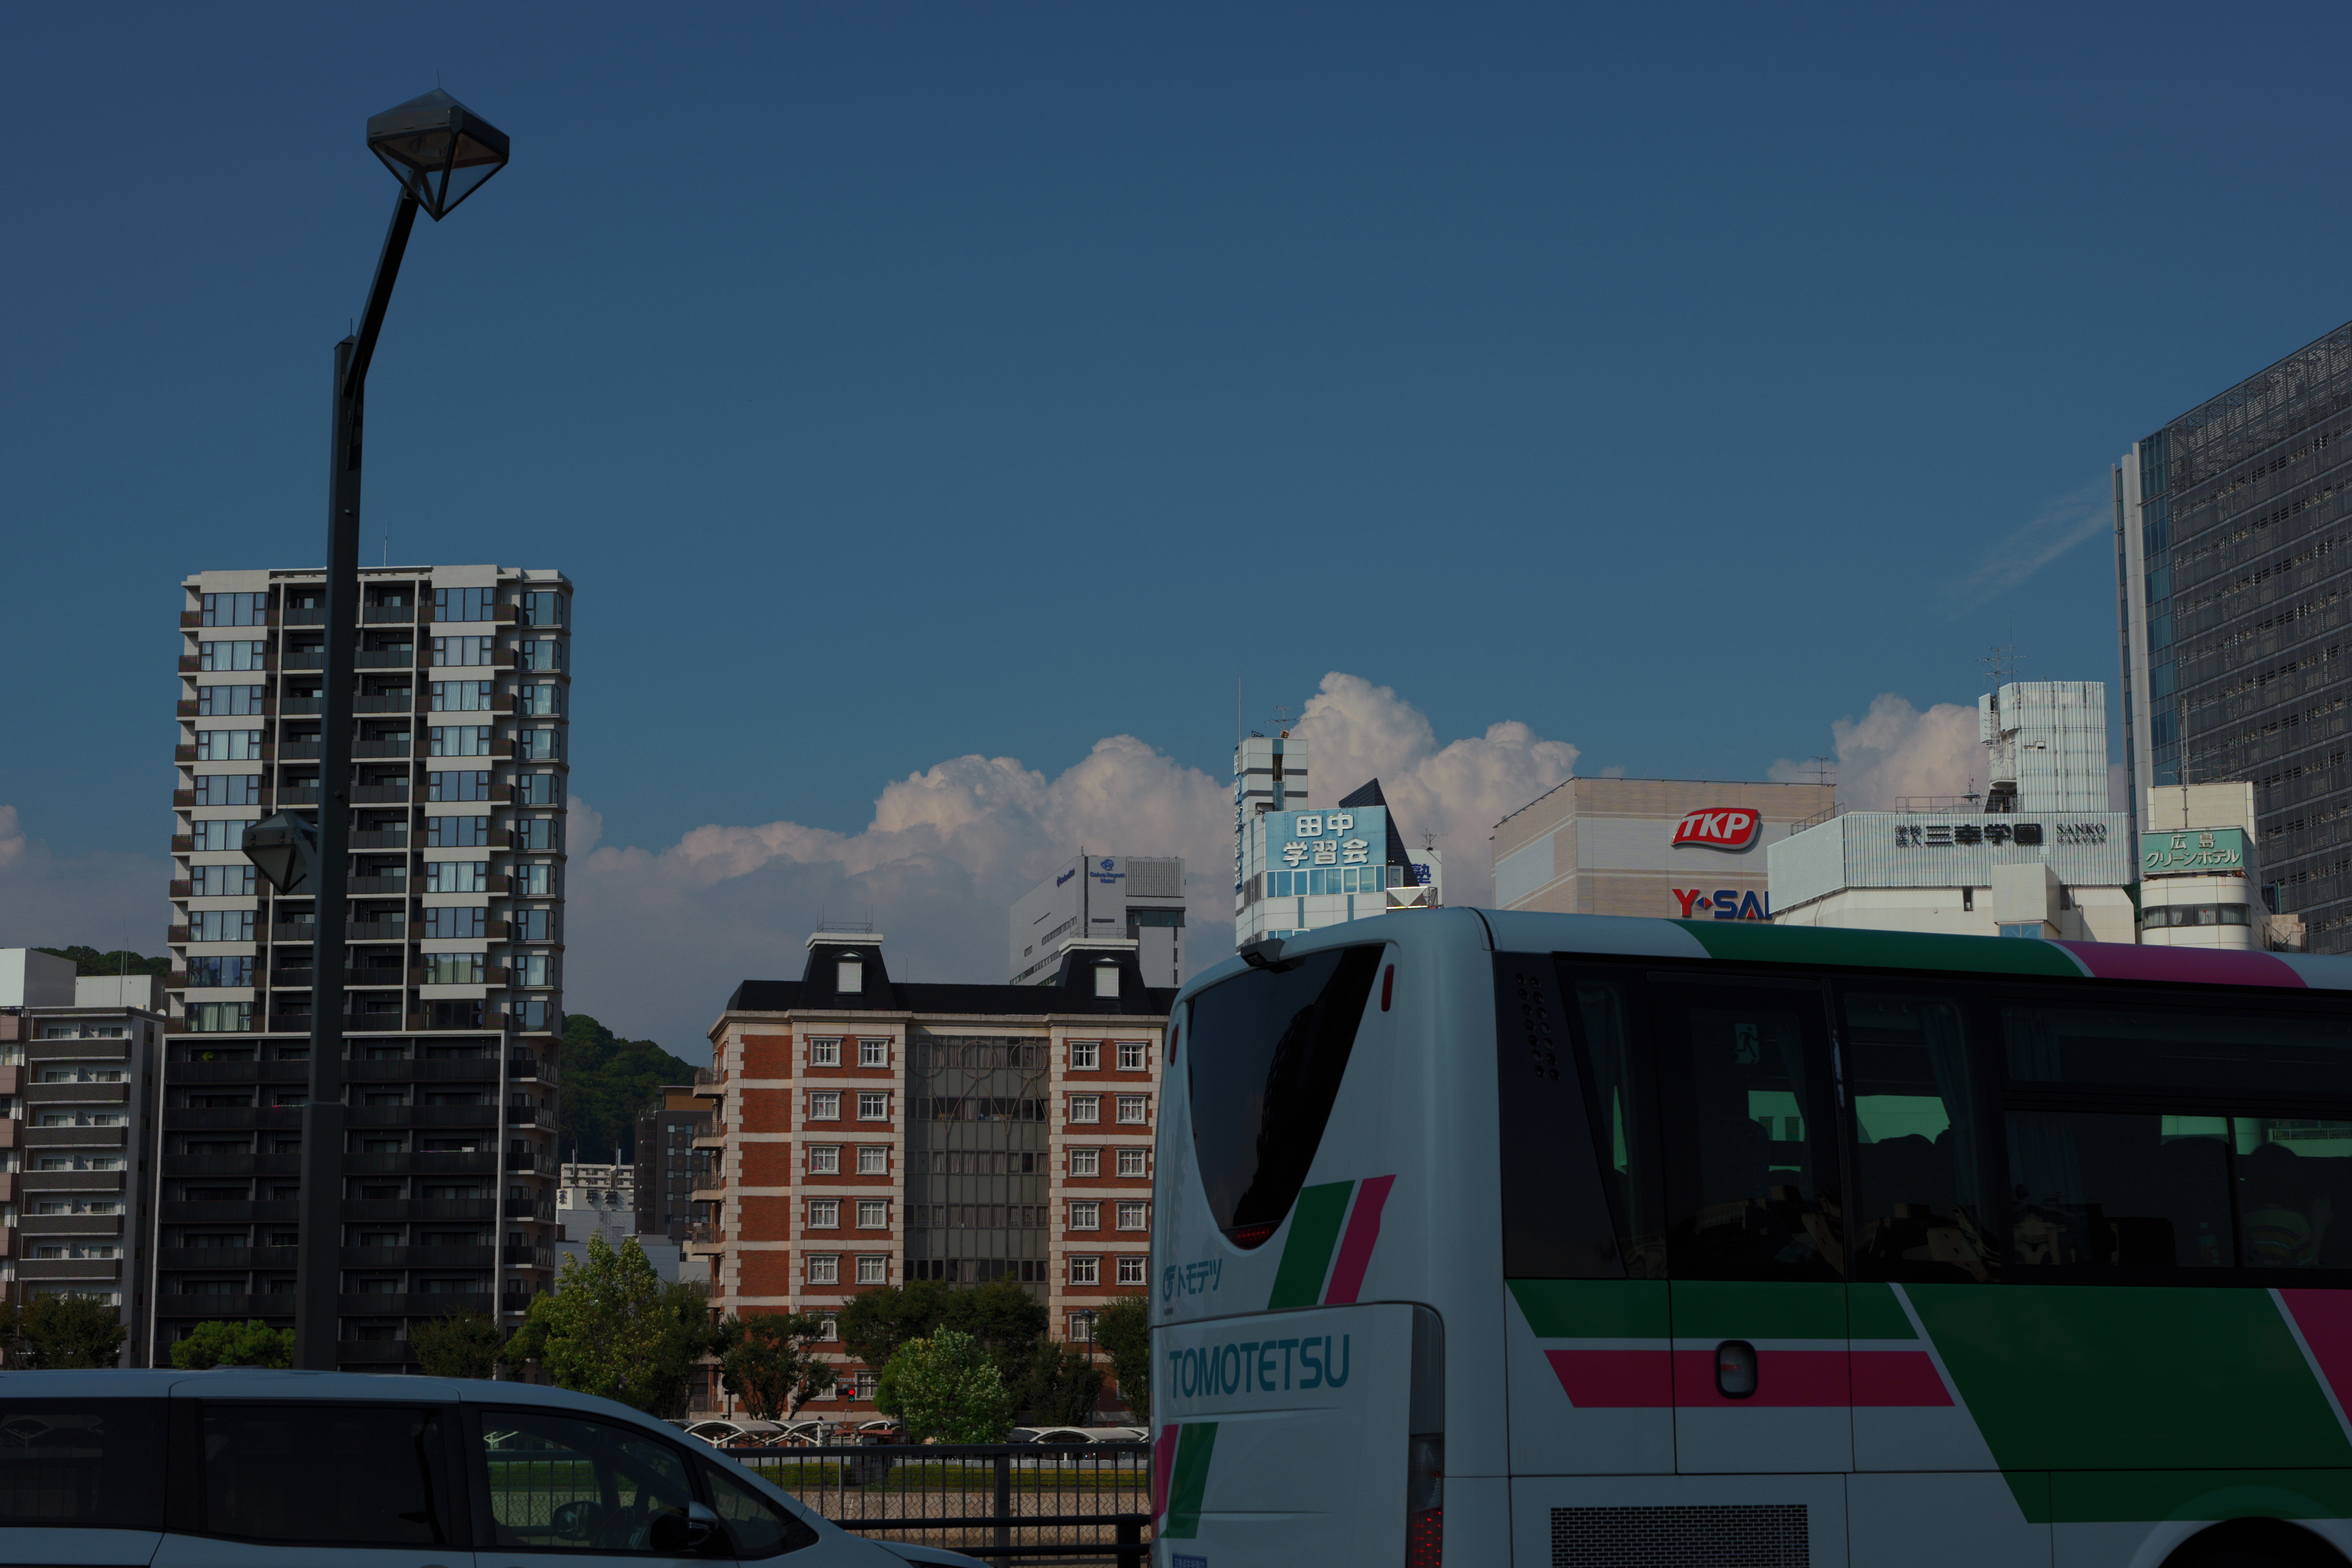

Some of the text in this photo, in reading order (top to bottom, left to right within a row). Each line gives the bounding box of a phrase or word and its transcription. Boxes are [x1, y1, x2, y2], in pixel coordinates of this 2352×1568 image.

[1296, 811, 1354, 837] 田中
[1681, 813, 1750, 839] TKP
[1895, 824, 1922, 835] 学校
[1925, 824, 2042, 844] 三幸学園
[2057, 823, 2105, 834] SANKO
[1895, 835, 1922, 846] 法人
[2171, 831, 2215, 850] 広島
[1283, 837, 1368, 867] 学習会
[2145, 849, 2241, 867] グリーンホテル
[1178, 1258, 1222, 1297] トモテツ
[1169, 1334, 1350, 1399] TOMOTETSU
